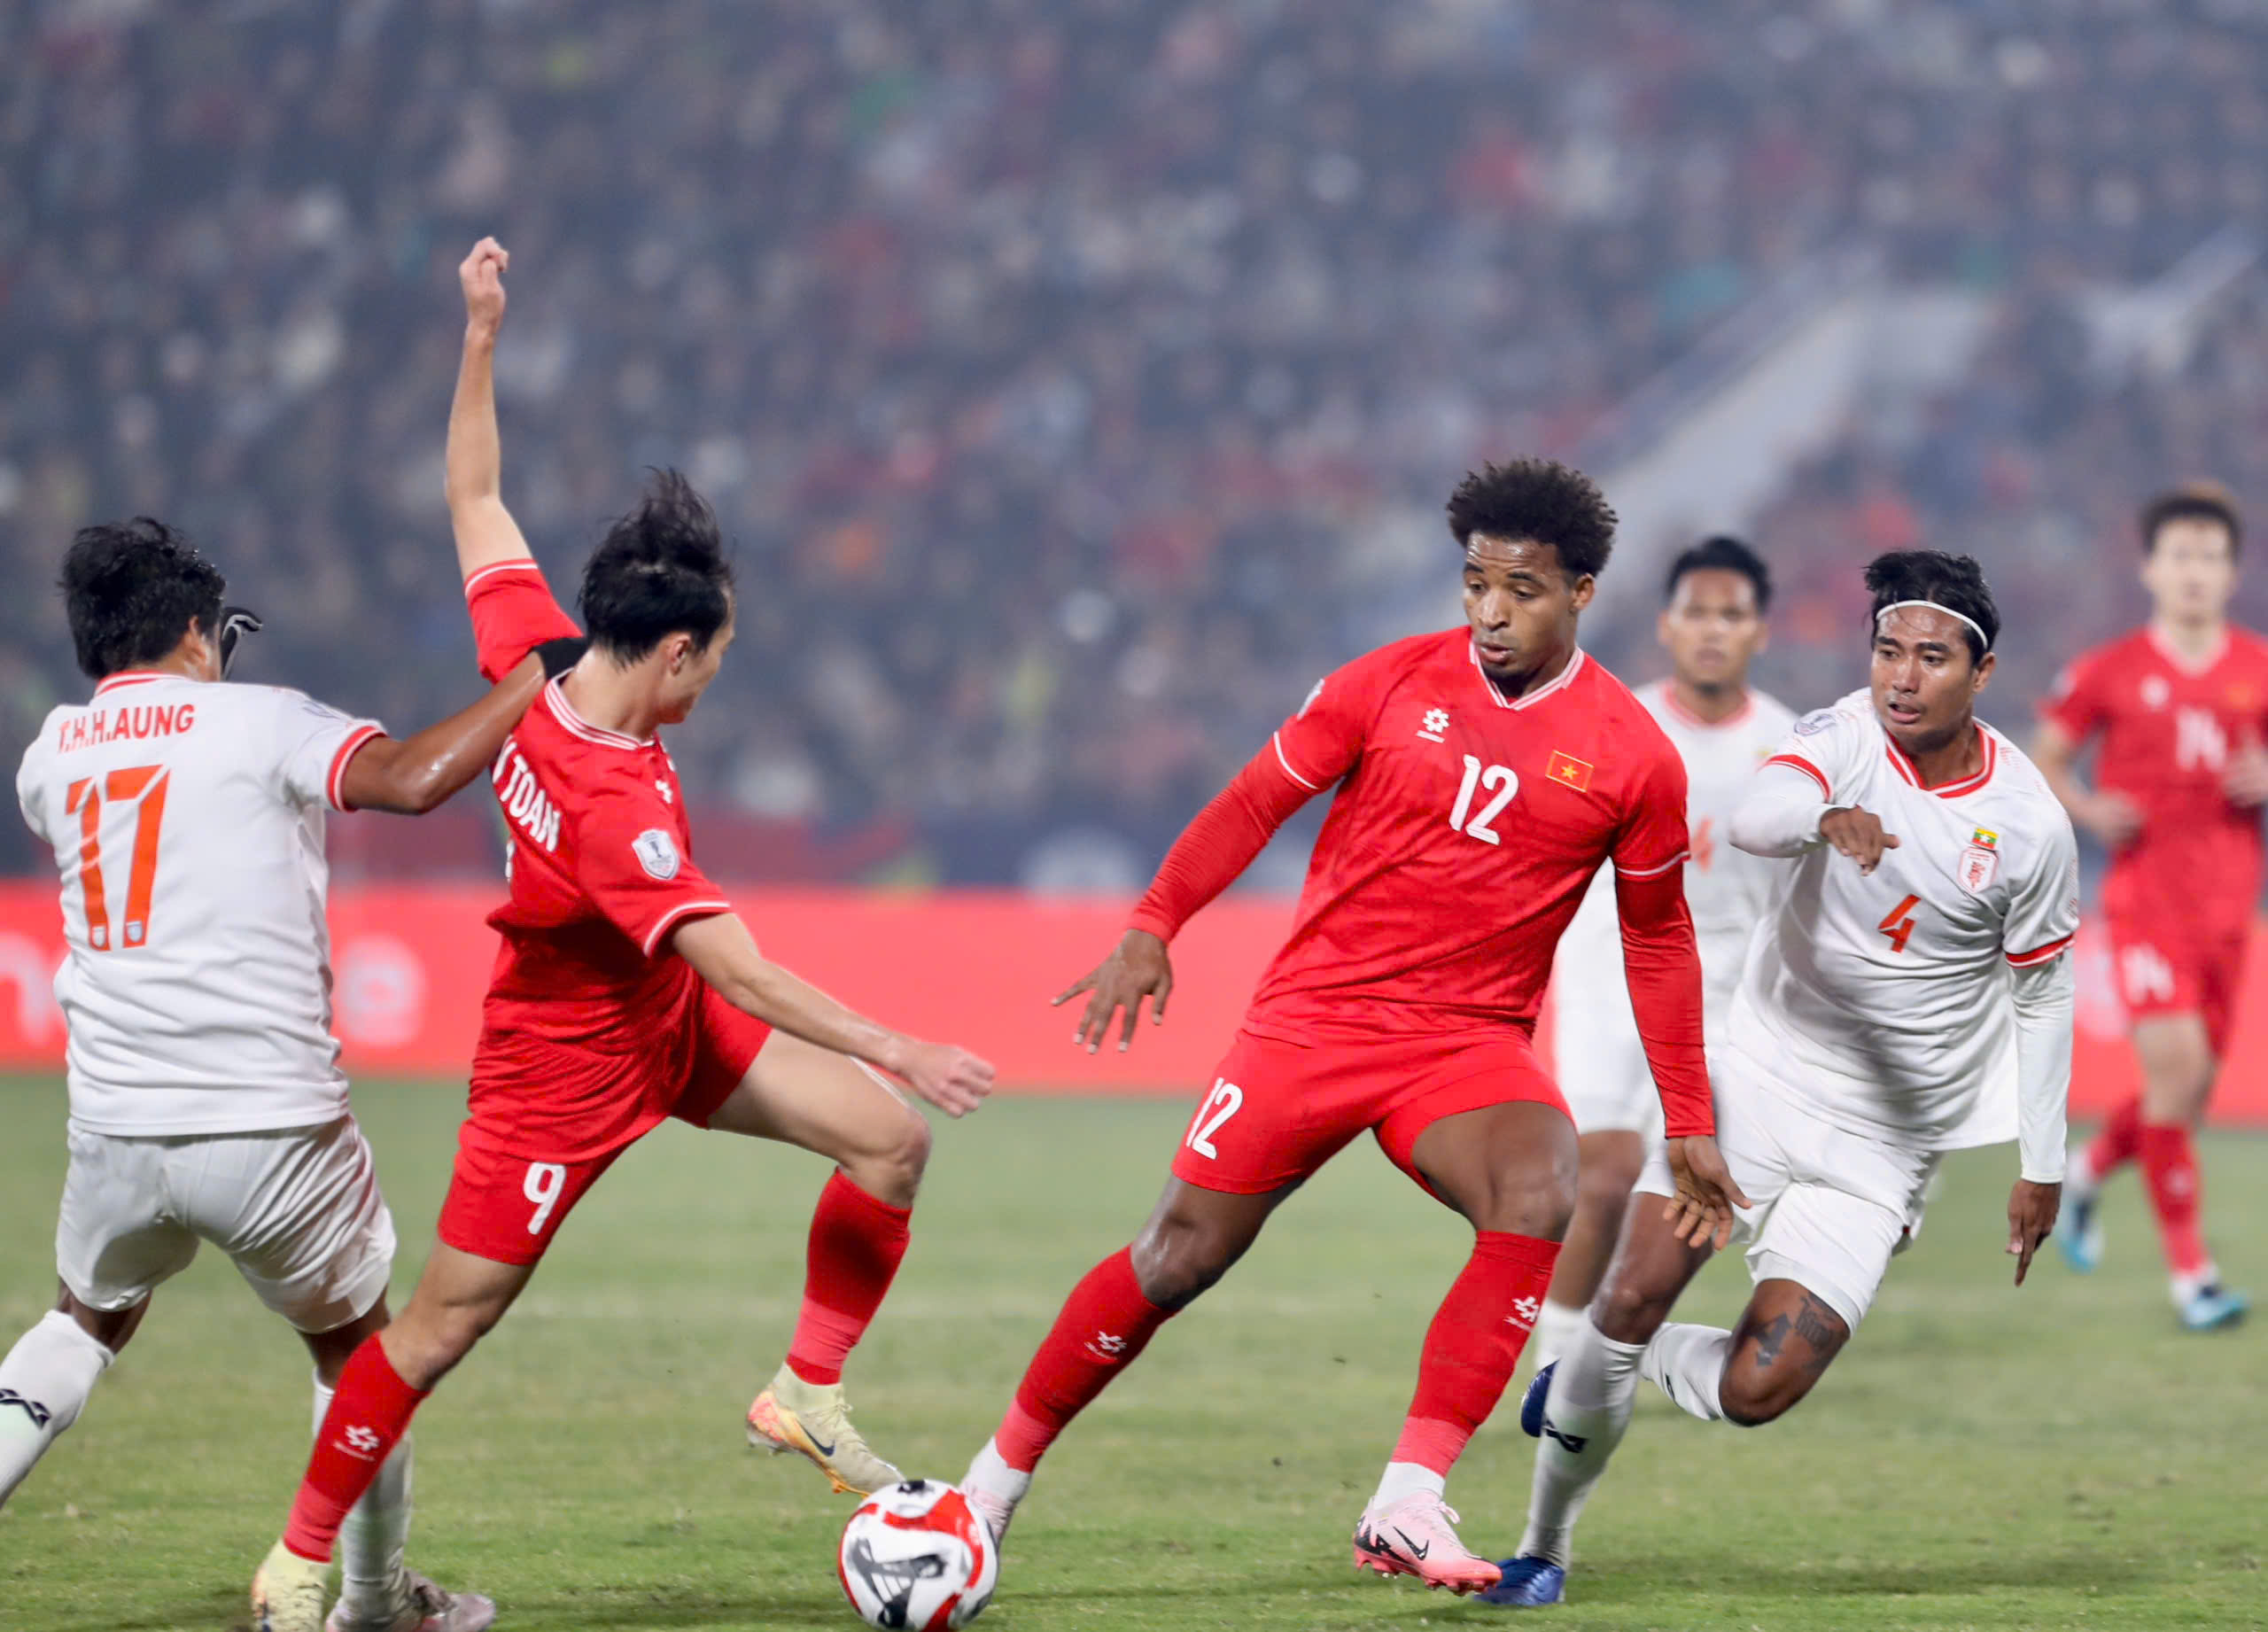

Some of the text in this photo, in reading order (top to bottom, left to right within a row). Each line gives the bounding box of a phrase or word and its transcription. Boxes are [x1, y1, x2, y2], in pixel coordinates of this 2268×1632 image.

[500, 755, 561, 852] TOAN
[1449, 754, 1519, 845] 12
[66, 765, 170, 951] 17
[1878, 894, 1921, 952] 4
[1186, 1077, 1243, 1160] 12
[524, 1162, 565, 1234] 9
